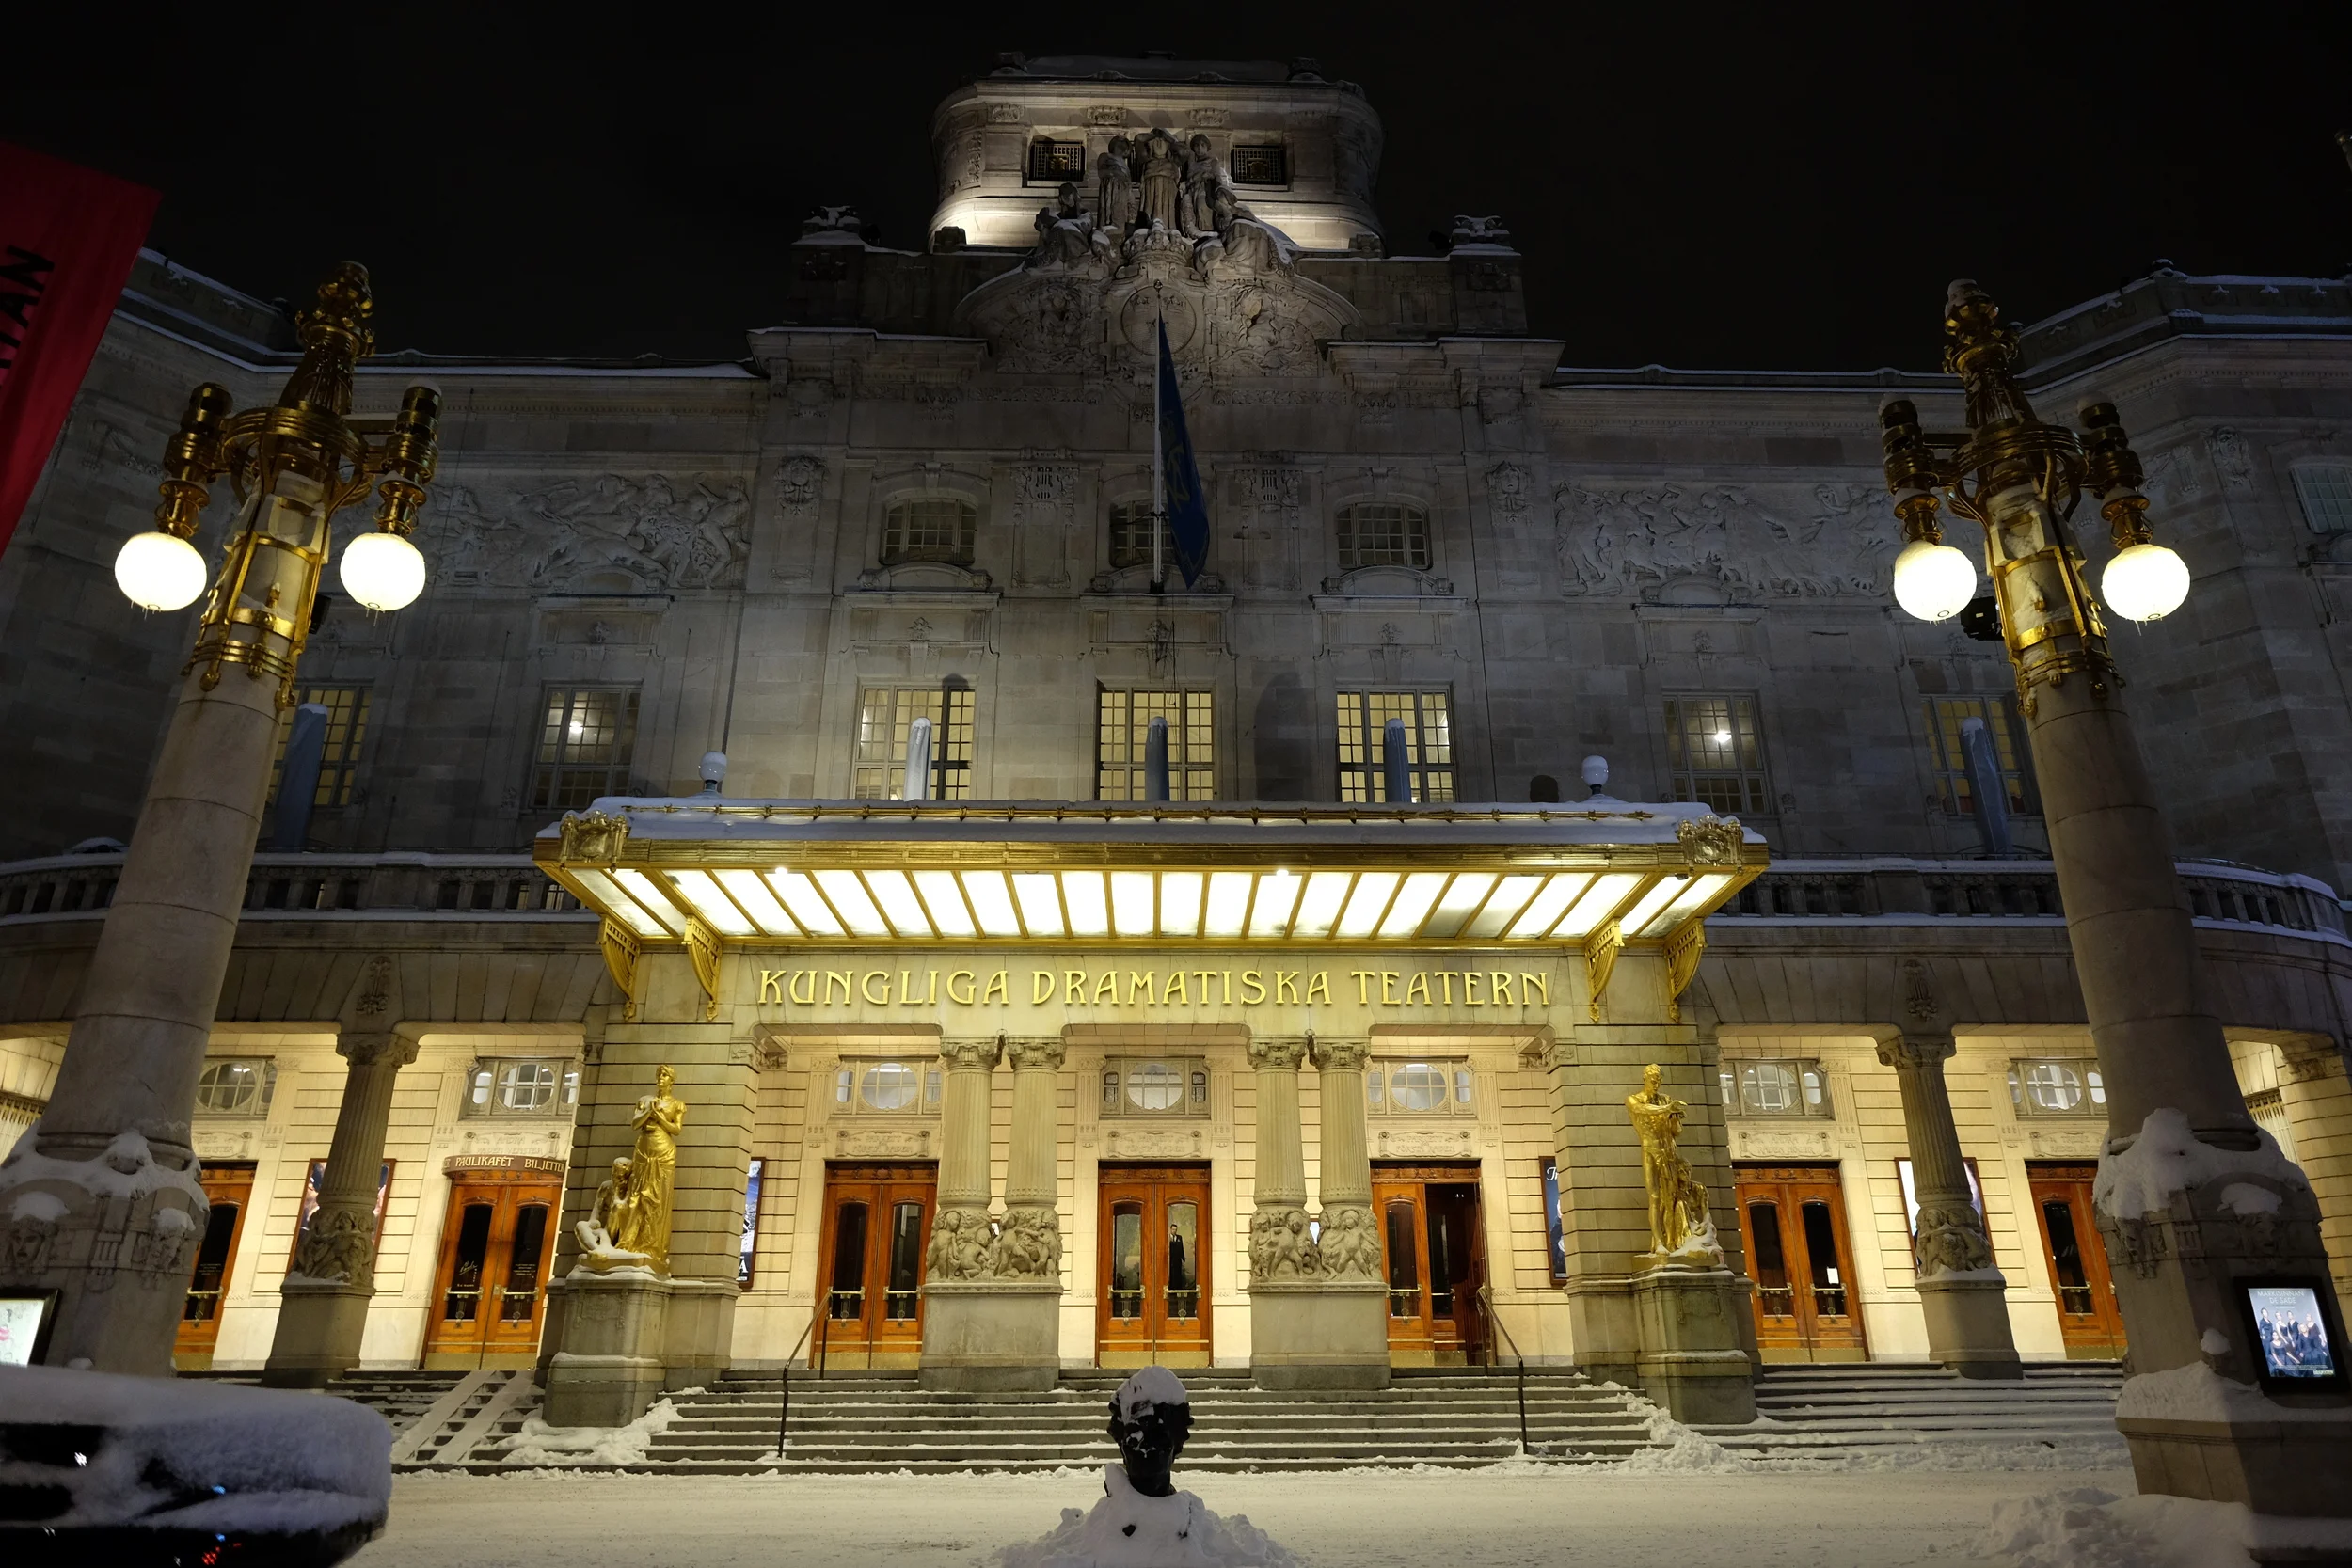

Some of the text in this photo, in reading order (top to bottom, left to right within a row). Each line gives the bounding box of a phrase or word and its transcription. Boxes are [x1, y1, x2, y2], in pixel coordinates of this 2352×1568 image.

[757, 970, 1549, 1006] KUNGLIGA DRAMATISKA TEATERN
[455, 1156, 515, 1167] PAULIKAFÉT
